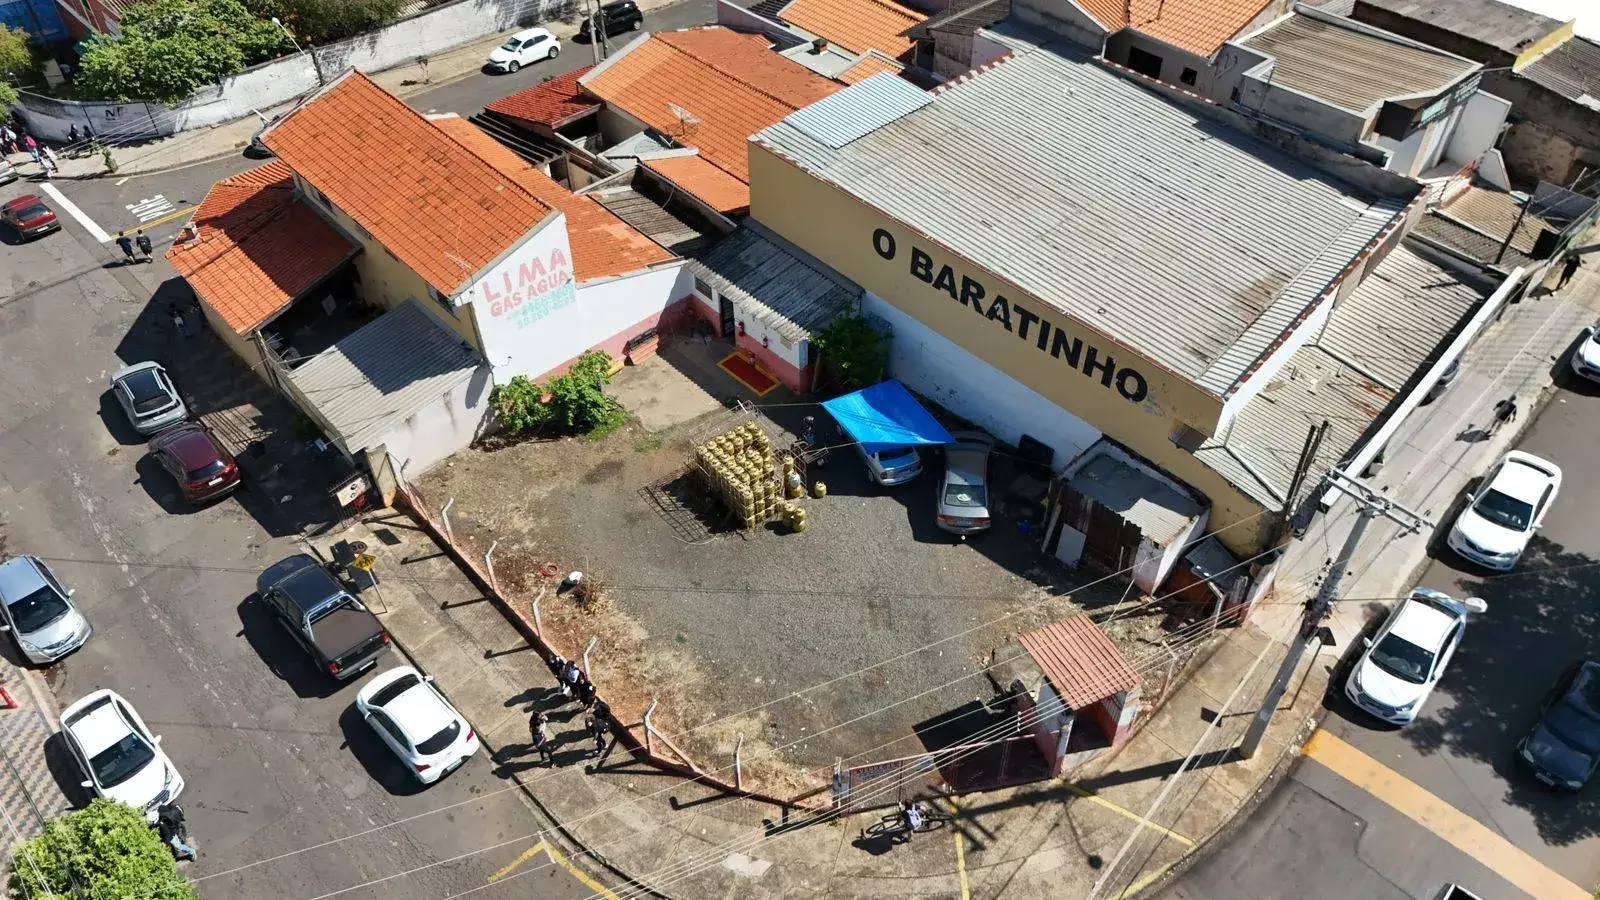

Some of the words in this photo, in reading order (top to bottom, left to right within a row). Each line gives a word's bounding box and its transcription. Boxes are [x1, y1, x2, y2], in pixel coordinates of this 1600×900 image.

[482, 247, 567, 303] LIMA
[490, 291, 523, 317] GAS
[872, 228, 896, 261] O
[910, 246, 1148, 403] BARATINHO
